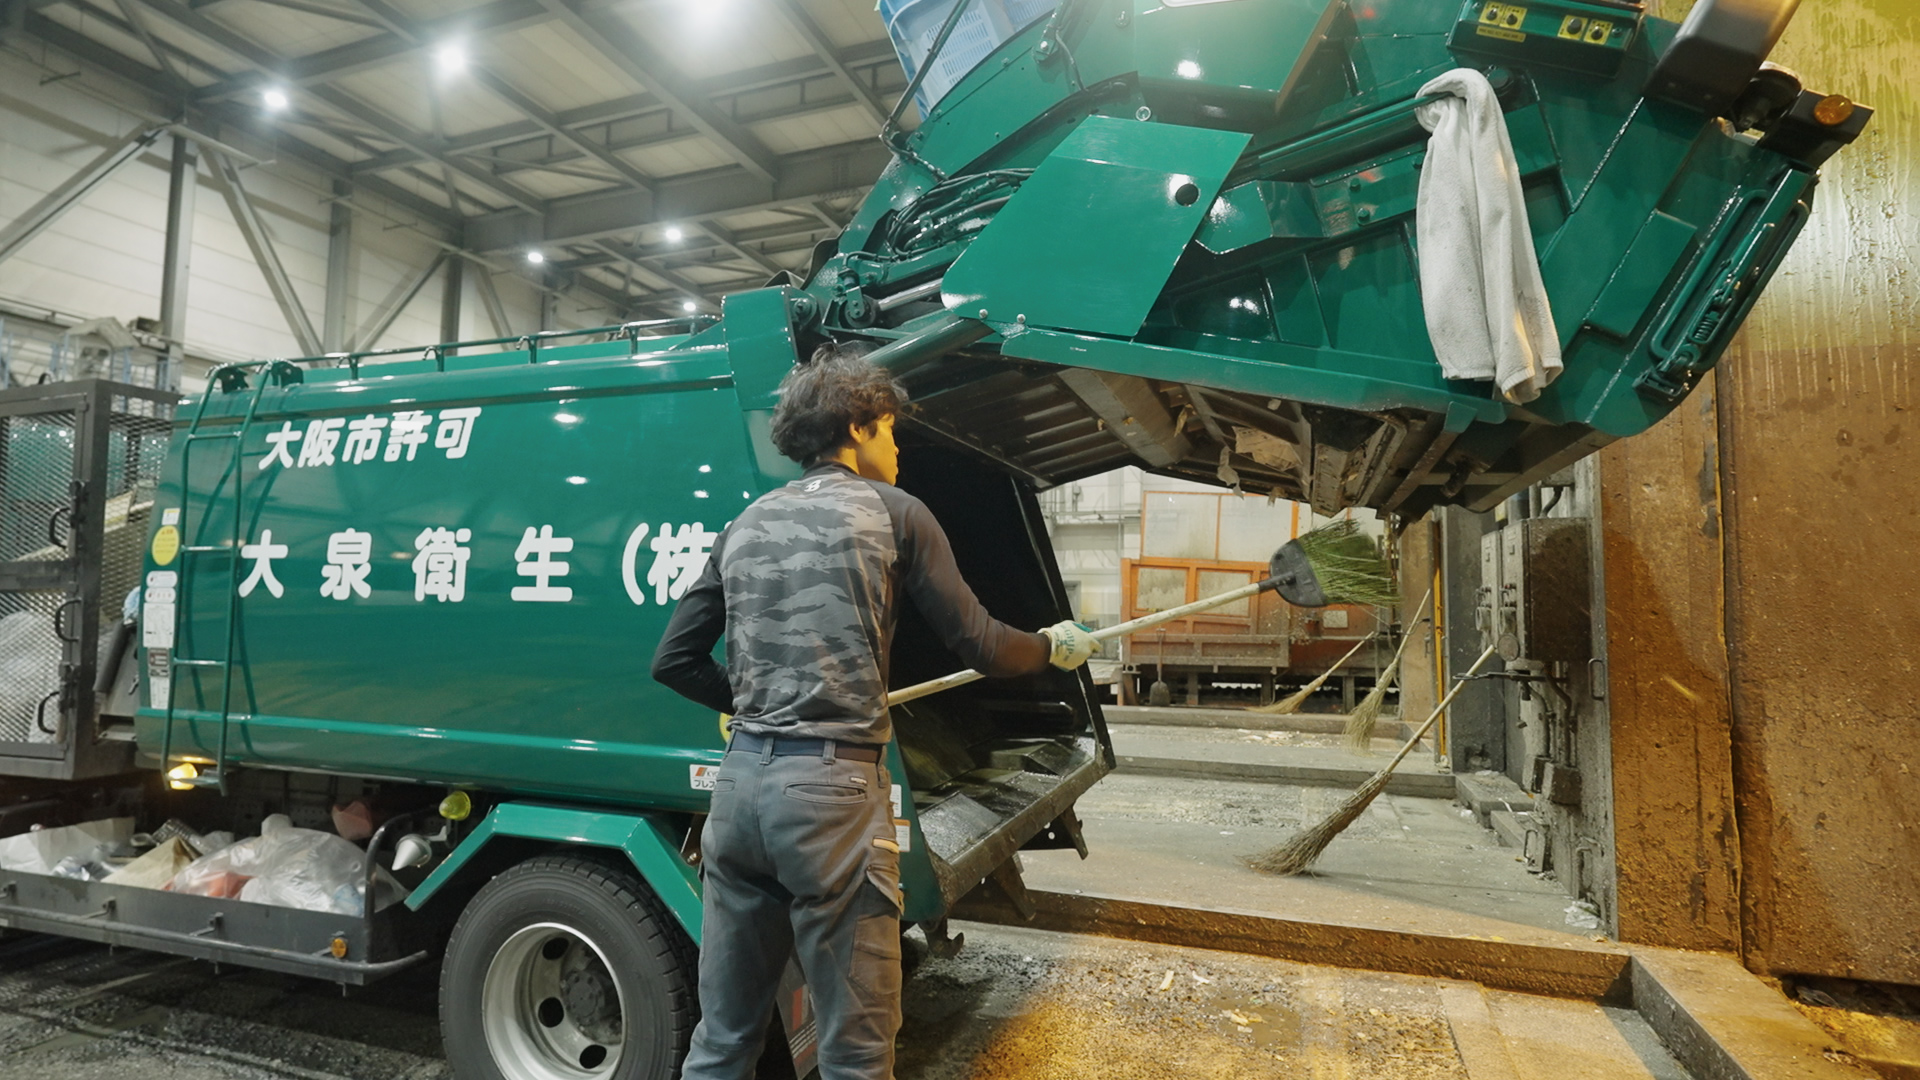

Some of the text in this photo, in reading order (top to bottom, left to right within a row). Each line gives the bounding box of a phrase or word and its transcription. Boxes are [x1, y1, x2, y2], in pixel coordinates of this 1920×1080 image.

[258, 407, 482, 470] 大阪市許可
[238, 521, 733, 606] 大泉衛生(株
